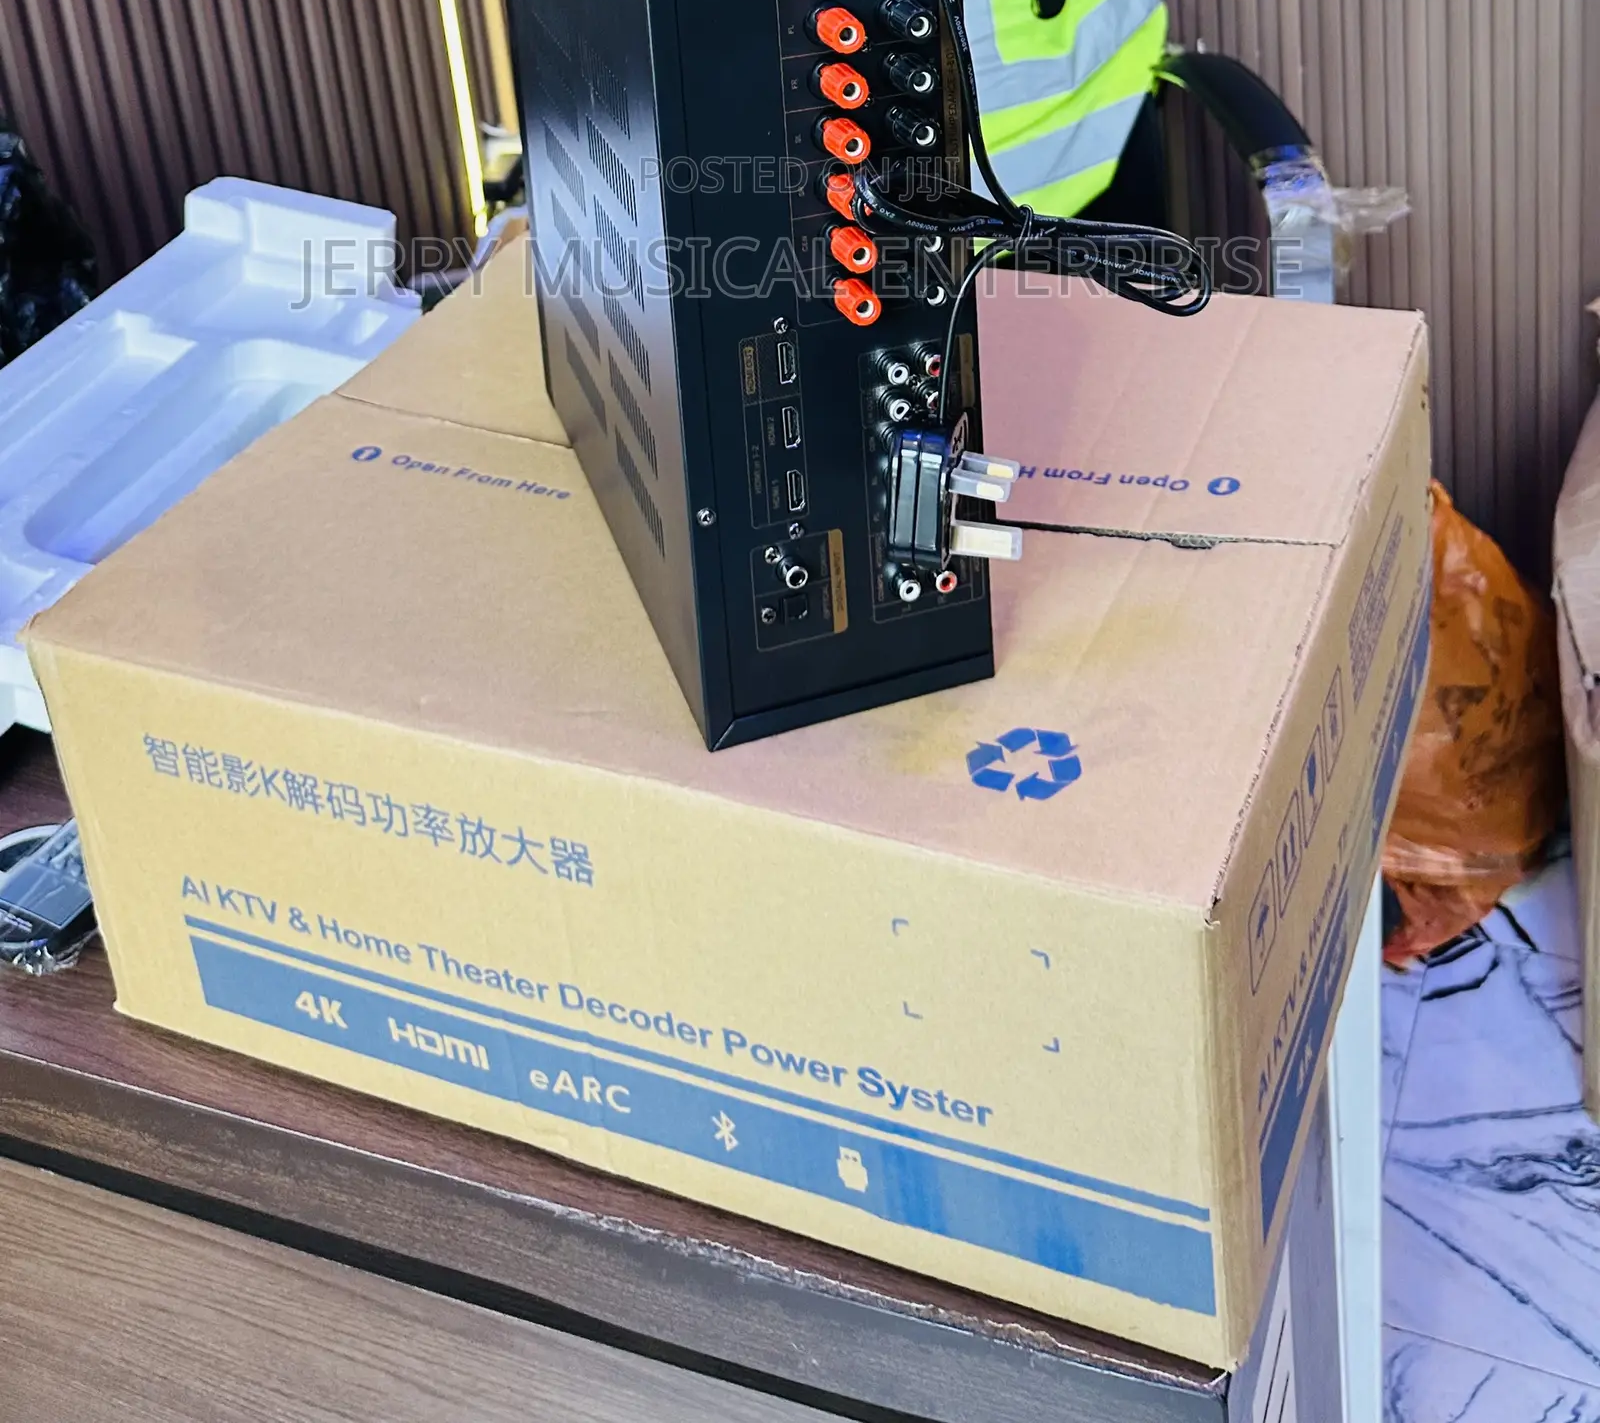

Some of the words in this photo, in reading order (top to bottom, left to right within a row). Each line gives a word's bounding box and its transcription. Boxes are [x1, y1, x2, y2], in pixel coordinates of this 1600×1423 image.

[391, 454, 451, 475] Open
[453, 466, 513, 488] From
[515, 479, 572, 500] Here
[1043, 467, 1112, 486] From
[1119, 474, 1190, 492] Open
[142, 732, 595, 887] 智能影K解码功率放大器
[181, 875, 210, 907] AI
[216, 883, 277, 925] KTV
[288, 905, 312, 935] &
[317, 914, 412, 965] Home
[417, 942, 550, 1003] Theater
[557, 981, 714, 1049] Decoder
[722, 1027, 849, 1087] Power
[856, 1065, 994, 1128] Syster
[295, 990, 349, 1030] 4K
[387, 1016, 490, 1071] HDMI
[529, 1068, 632, 1114] eARC
